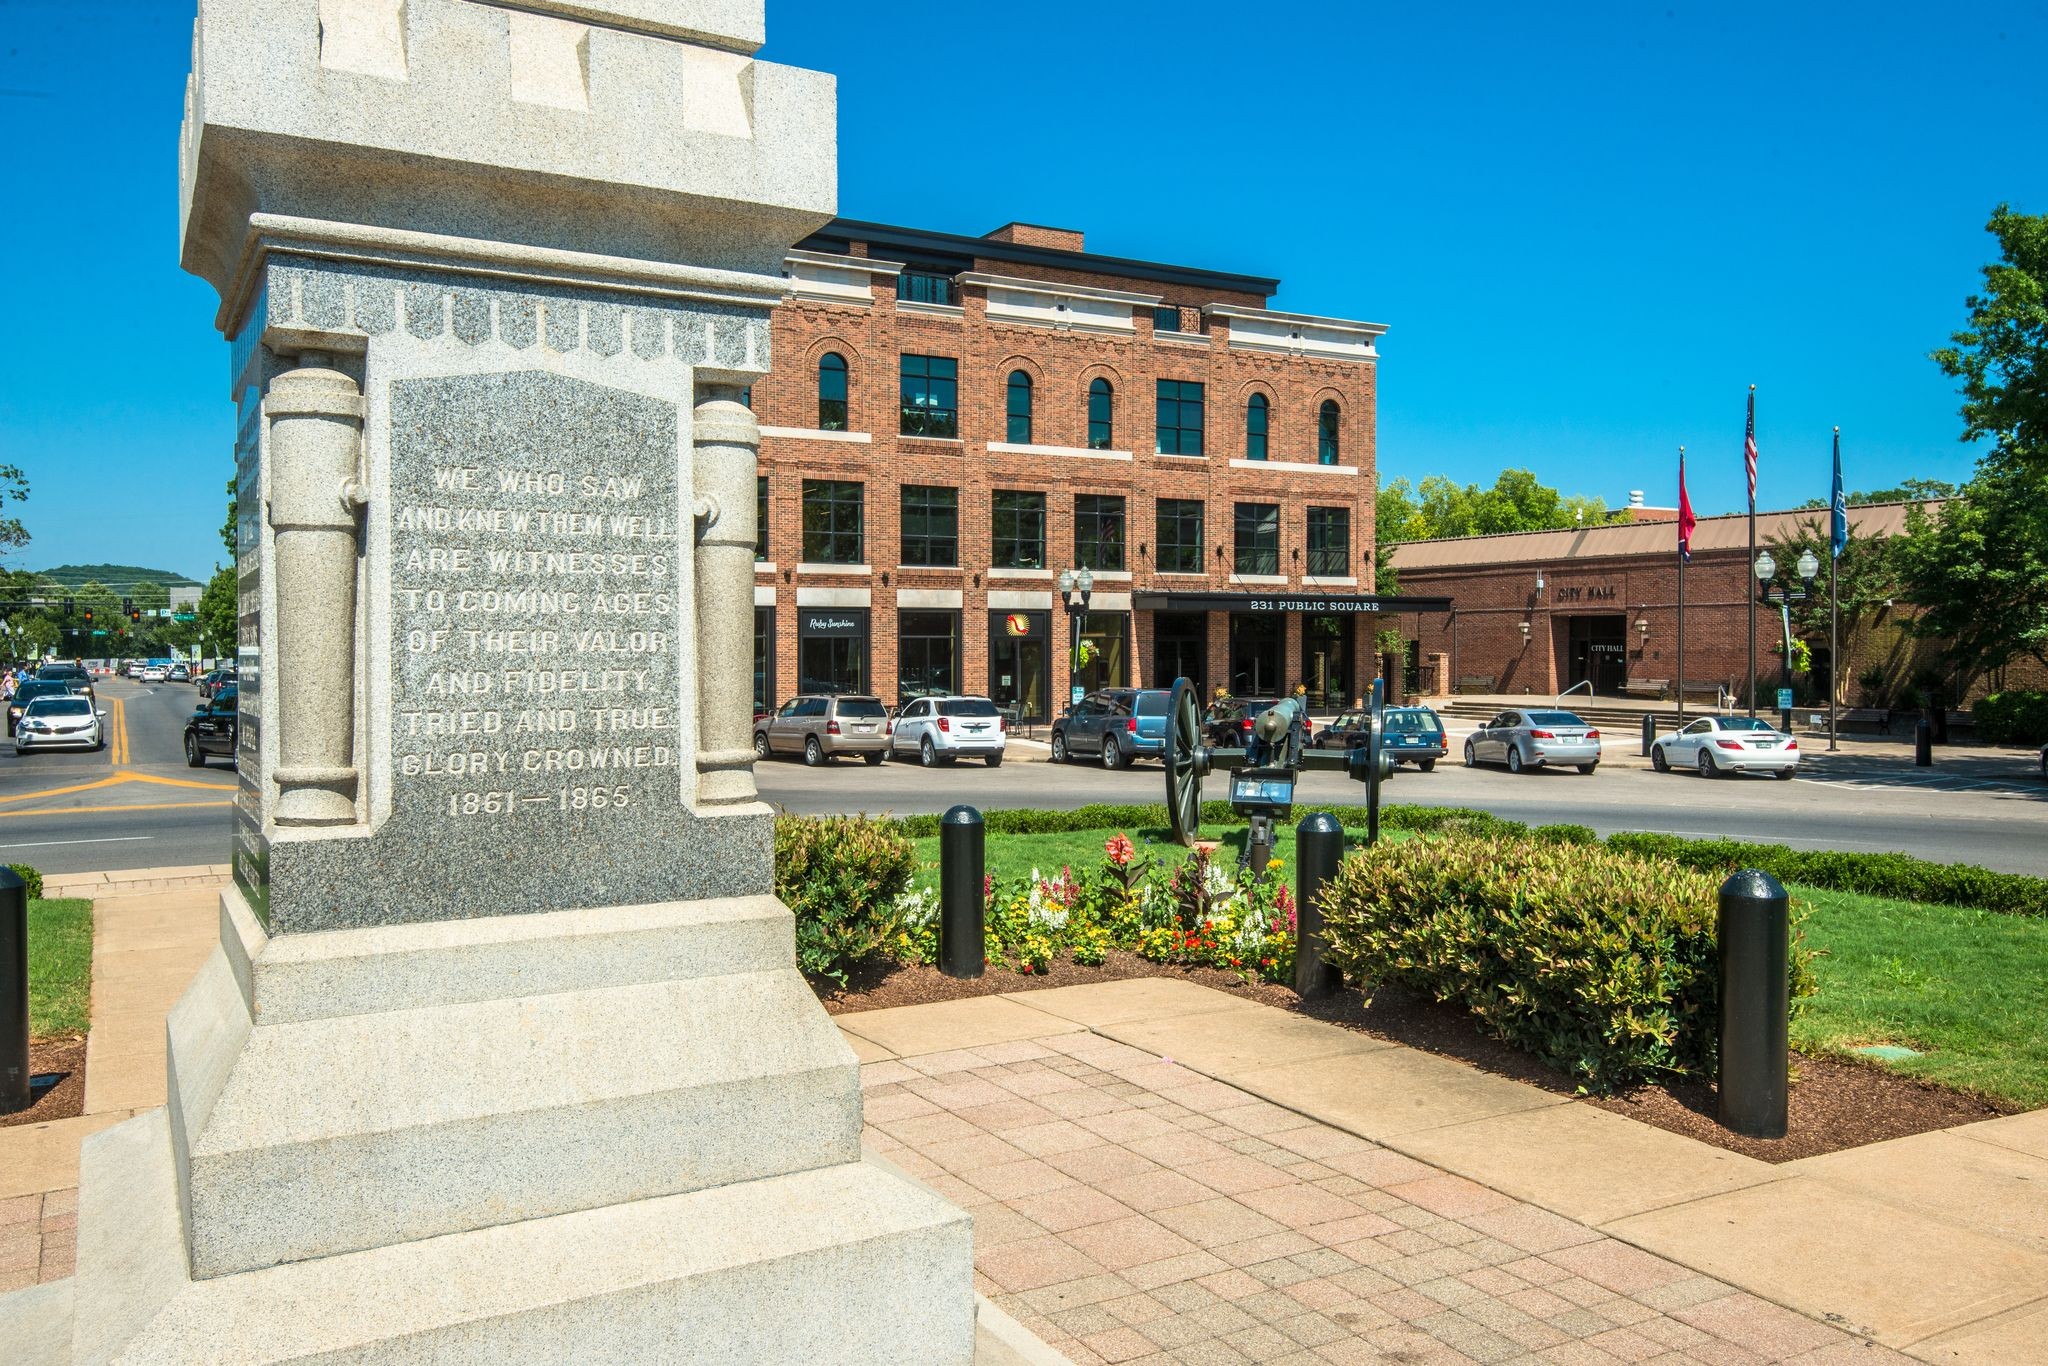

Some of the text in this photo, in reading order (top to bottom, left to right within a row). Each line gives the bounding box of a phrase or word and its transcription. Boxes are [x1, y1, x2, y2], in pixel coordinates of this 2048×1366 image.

[434, 466, 643, 499] WE WHO SAW
[399, 505, 452, 531] AND
[456, 506, 530, 534] KNEW
[536, 509, 602, 535] THEM
[405, 548, 668, 576] ARE WITNESSES
[400, 587, 672, 615] TO COMING AGES
[1250, 600, 1380, 612] 231 PUBLIC SQUARE
[1557, 585, 1616, 601] CITY HALL
[809, 618, 855, 630] Ruby Sunshine
[407, 629, 668, 653] OF THEIR VALOR
[1591, 644, 1624, 652] CITY HALL
[425, 669, 491, 694] AND
[401, 709, 503, 736] TRIED
[514, 708, 577, 733] AND
[401, 749, 511, 775] GLORY
[450, 789, 515, 816] 1861
